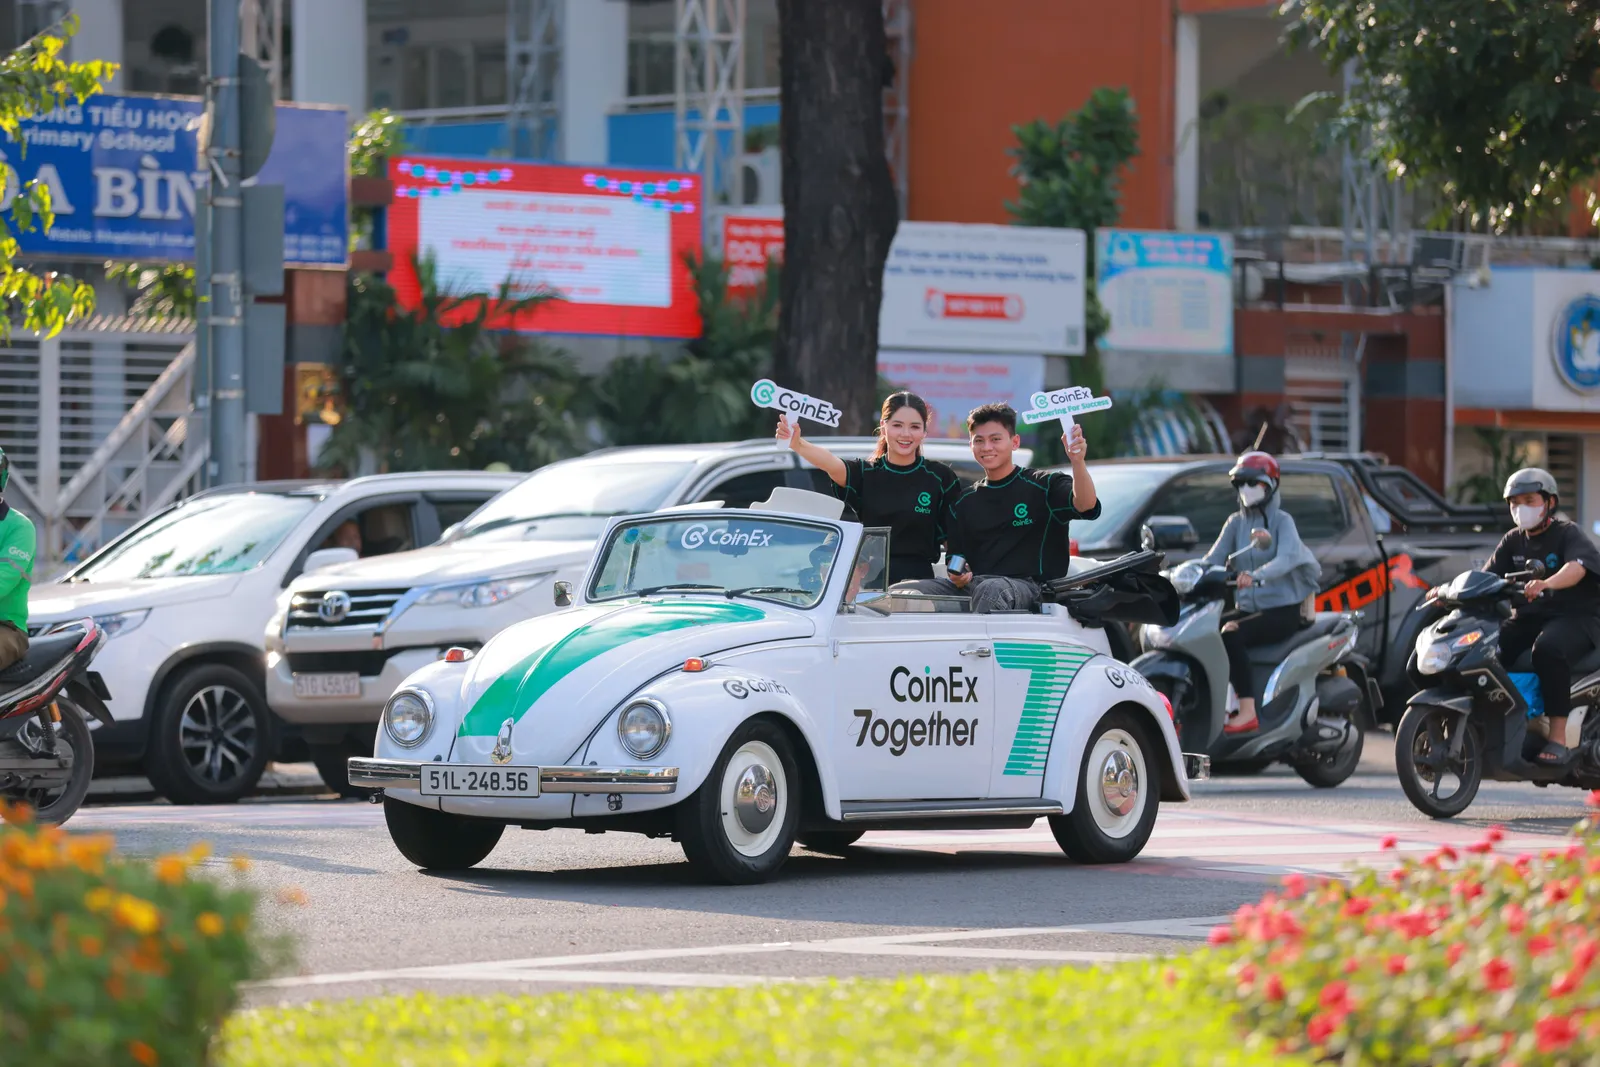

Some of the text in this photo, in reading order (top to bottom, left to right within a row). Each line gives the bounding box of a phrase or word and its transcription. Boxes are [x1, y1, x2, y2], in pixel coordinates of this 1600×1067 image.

[99, 129, 175, 152] School
[1050, 389, 1089, 404] CoinEx
[779, 393, 838, 424] CoinEx
[1026, 399, 1109, 420] Partnering For Success
[1012, 518, 1033, 527] CoinEx
[709, 528, 773, 546] CoinEx
[9, 546, 31, 561] Grab
[889, 665, 979, 703] CoinEx
